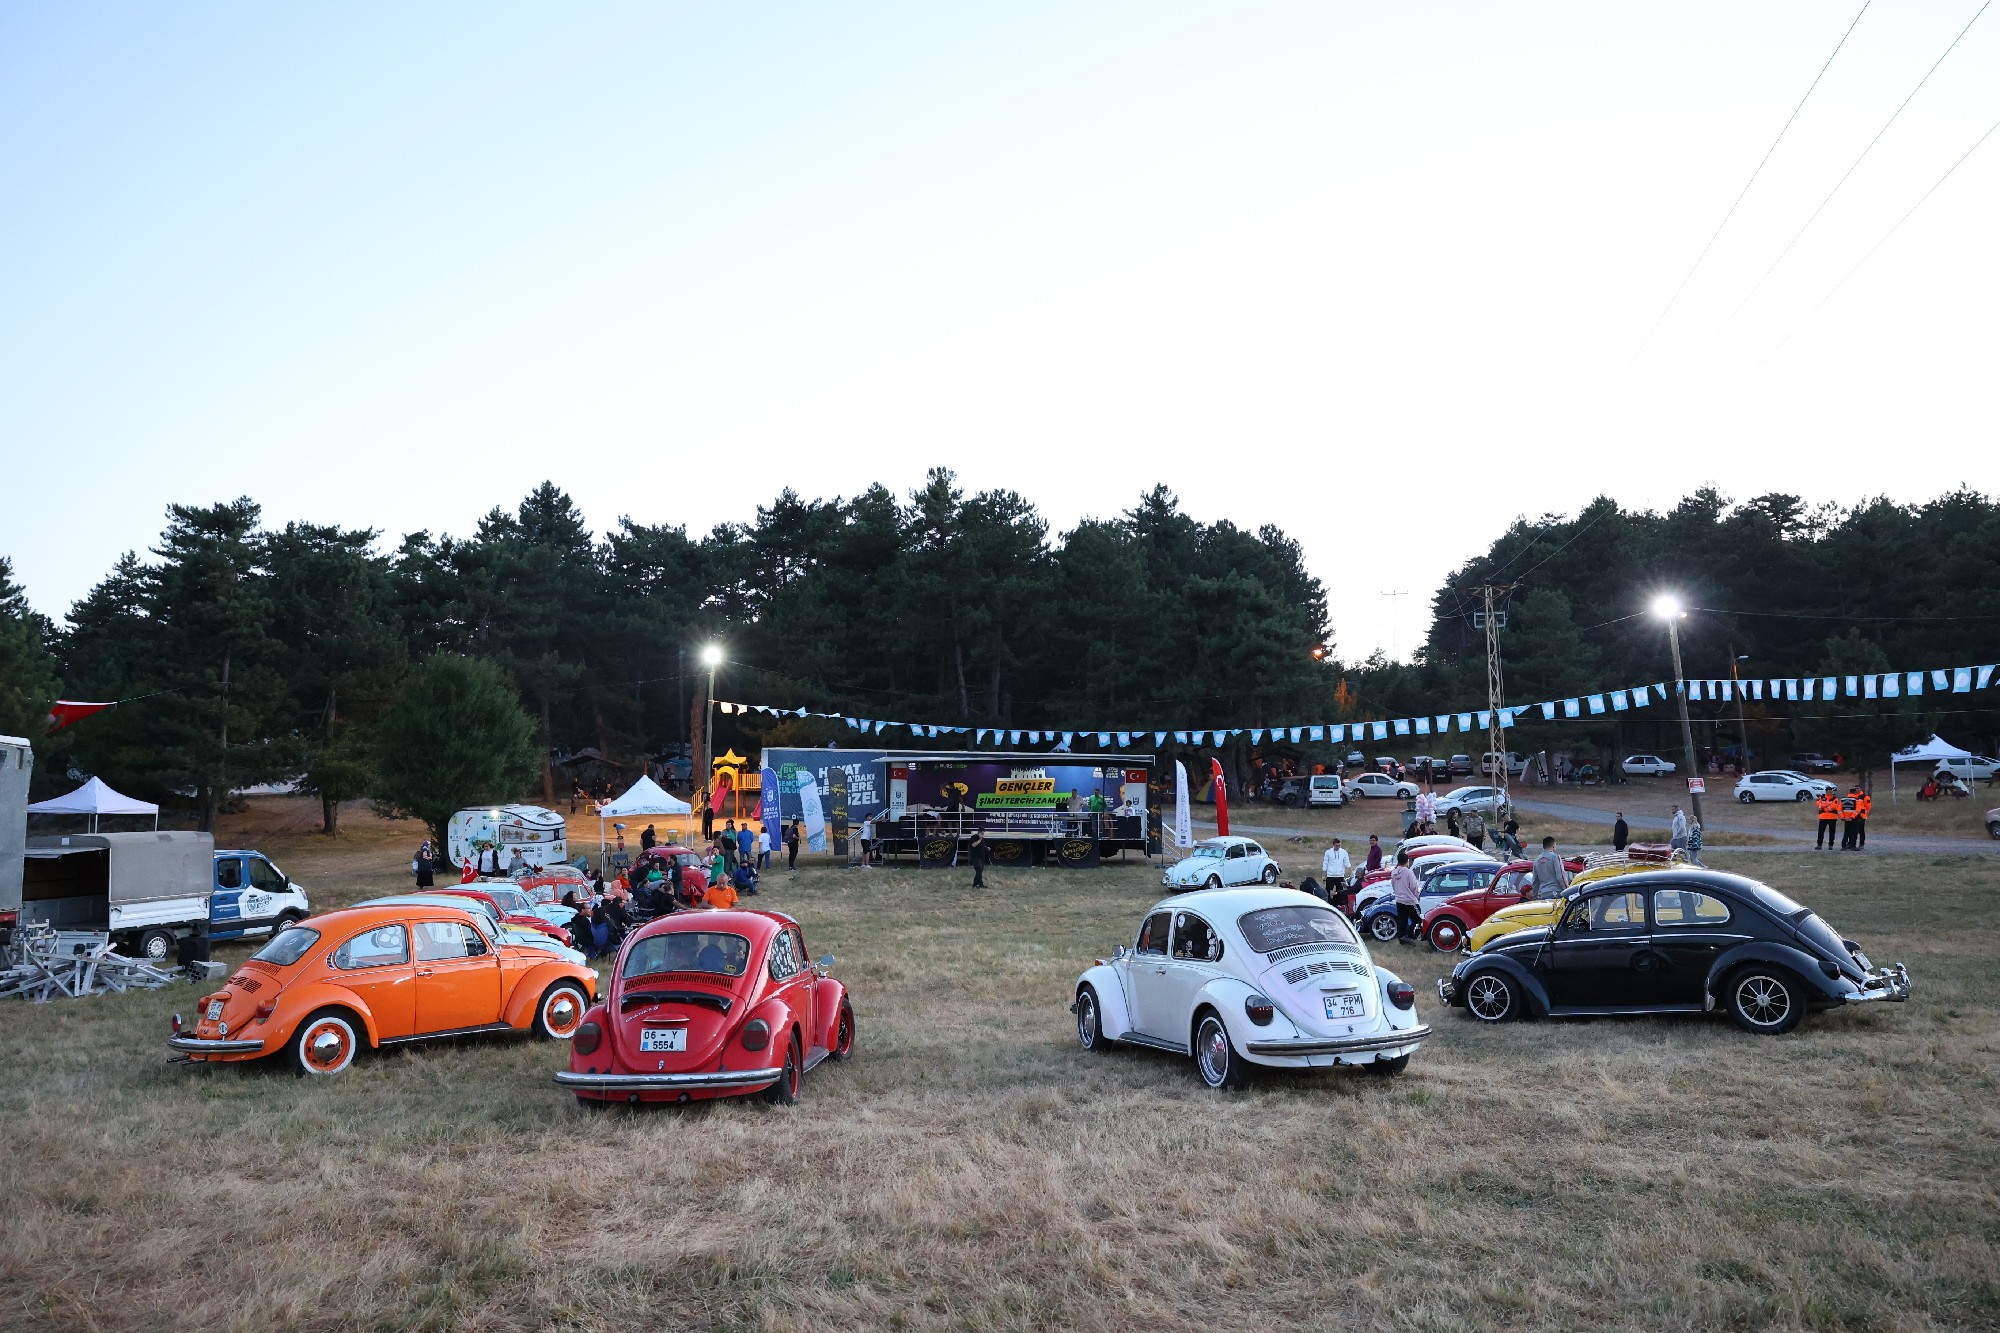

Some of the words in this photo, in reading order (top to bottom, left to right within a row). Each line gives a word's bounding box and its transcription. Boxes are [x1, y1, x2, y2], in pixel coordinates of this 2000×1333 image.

[819, 763, 861, 778] HYAT
[999, 782, 1052, 794] GENÇLER
[979, 796, 1004, 806] ŞİMDİ
[1005, 796, 1035, 804] TERCİH
[1326, 998, 1337, 1007] 34
[1343, 996, 1361, 1006] FPM
[1340, 1006, 1355, 1016] 716
[644, 1031, 656, 1040] 06
[672, 1031, 678, 1040] Y
[652, 1041, 674, 1050] 5554
